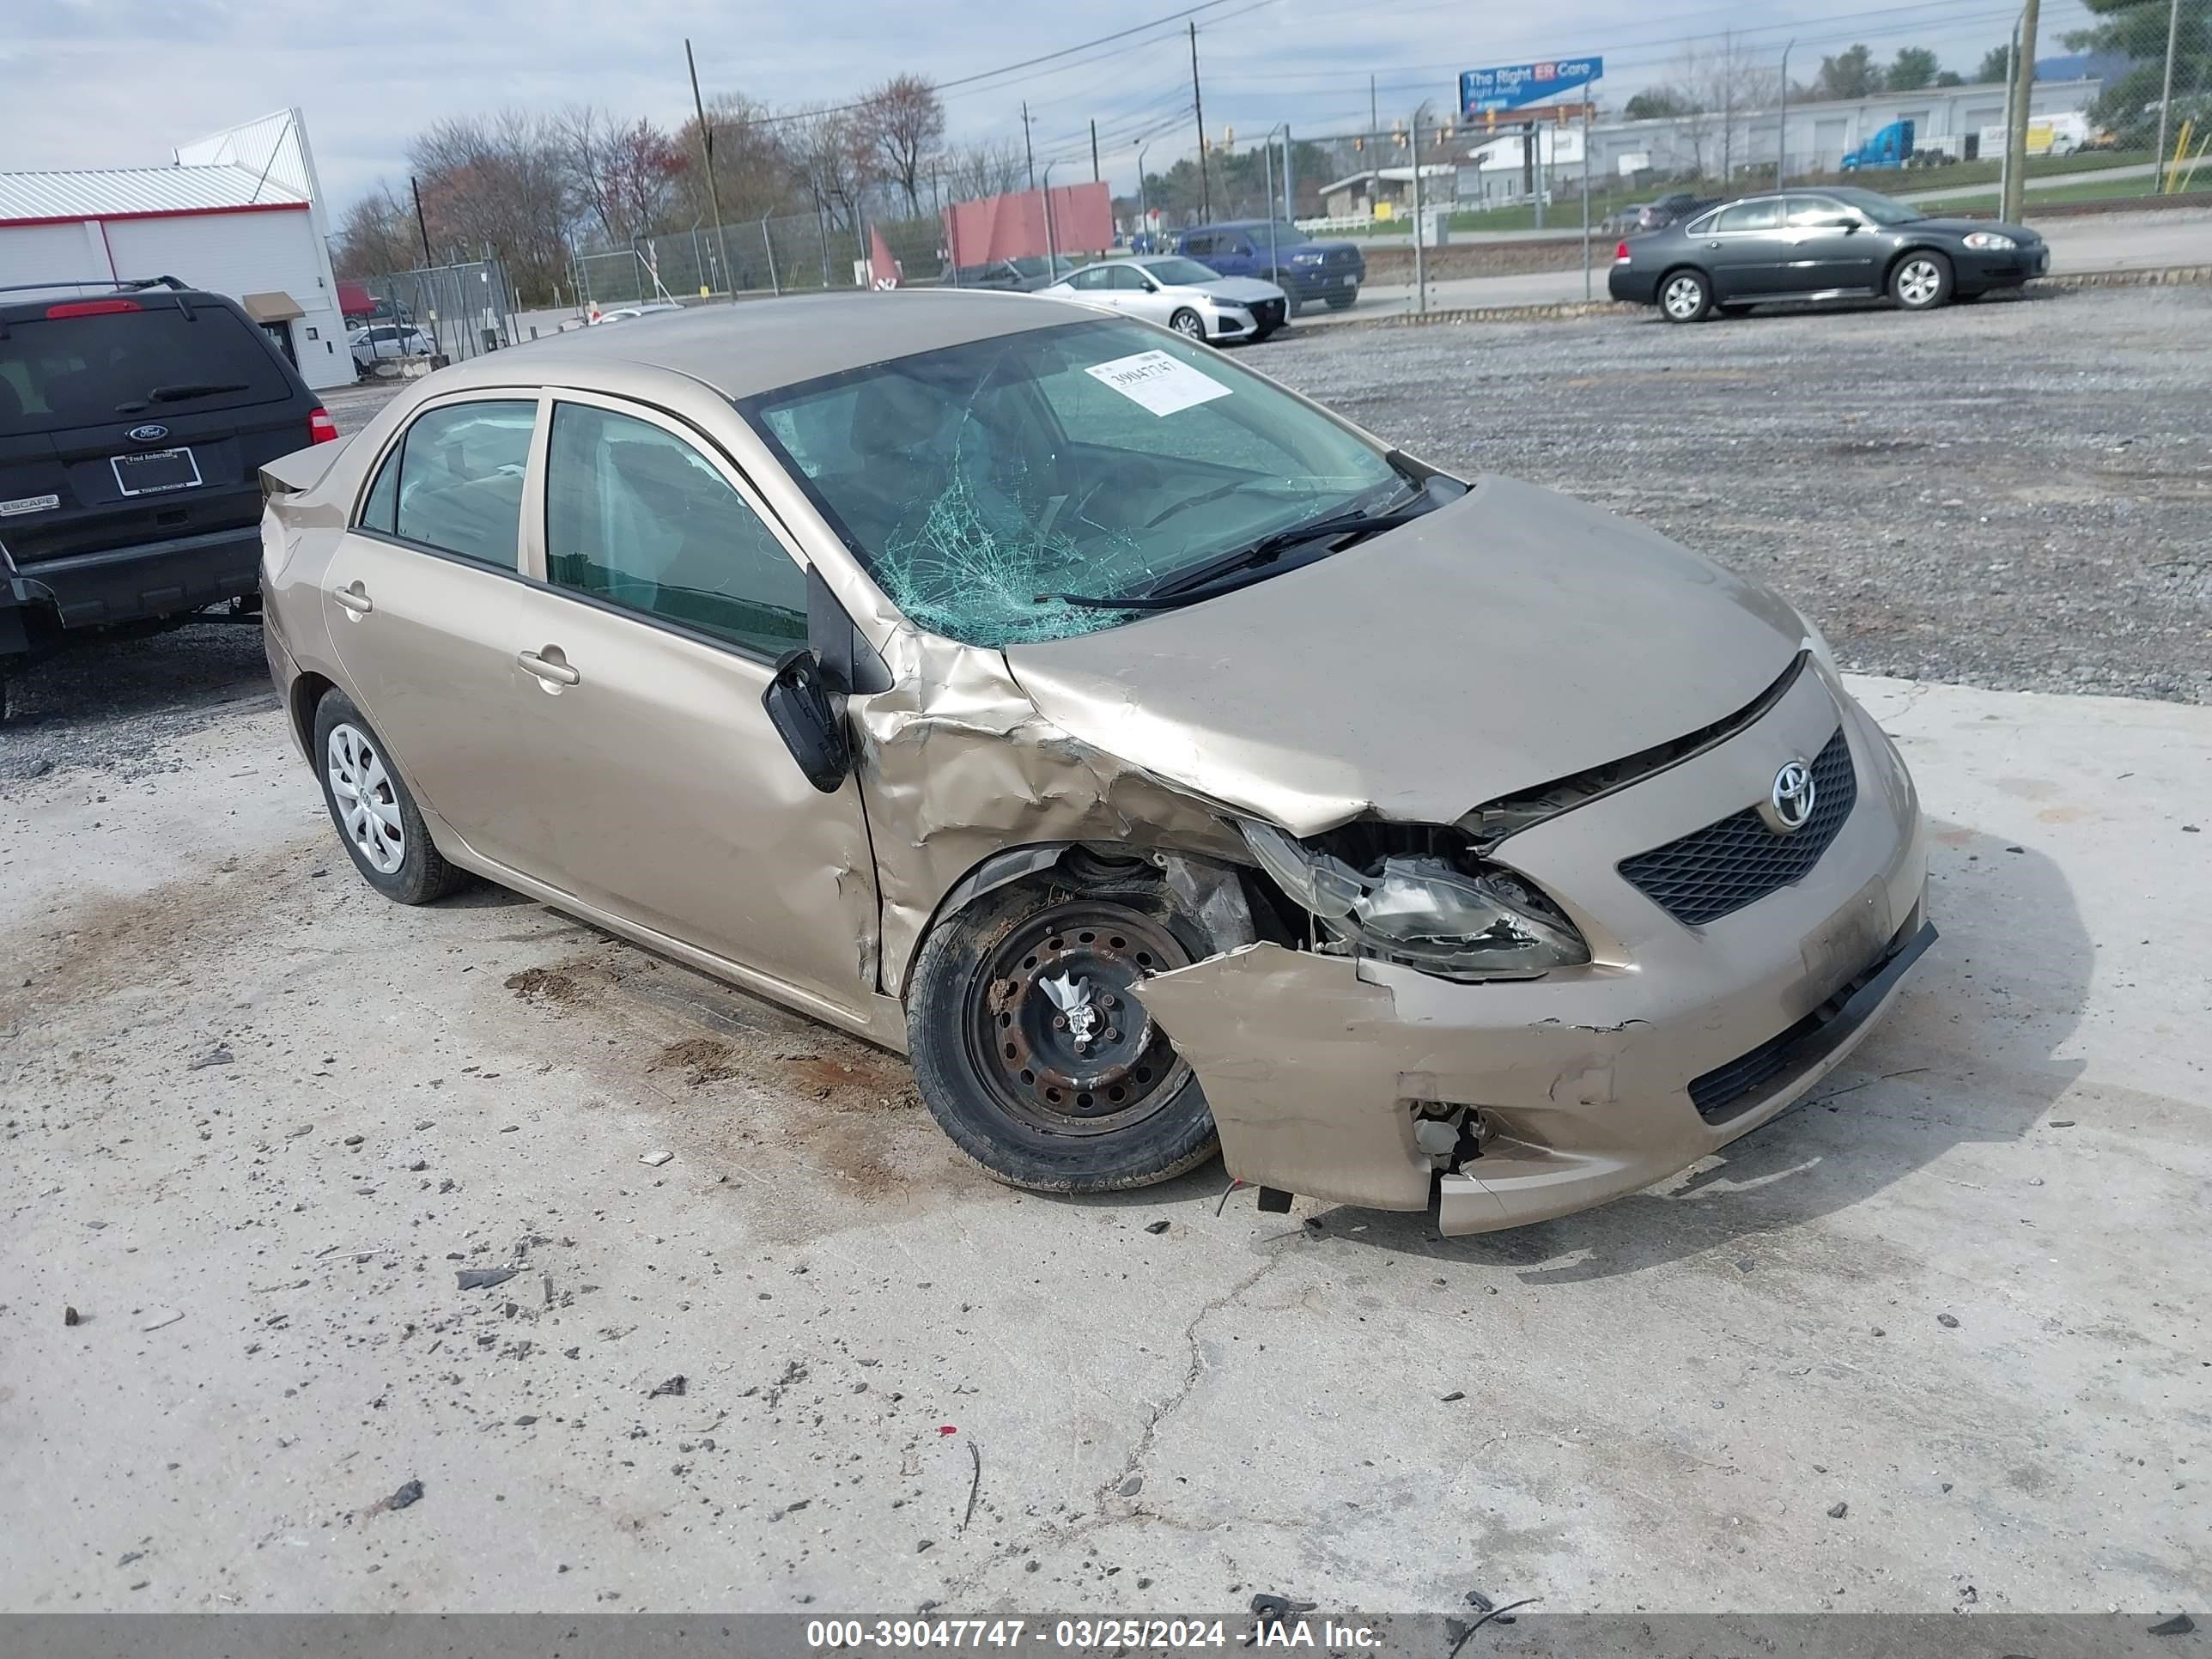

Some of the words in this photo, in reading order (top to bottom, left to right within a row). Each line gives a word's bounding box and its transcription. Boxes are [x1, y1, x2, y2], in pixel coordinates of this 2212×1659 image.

[1468, 72, 1493, 87] The
[1496, 66, 1532, 86] Right
[1534, 64, 1556, 81] ER
[1557, 62, 1590, 77] Care
[1468, 88, 1492, 99] Right
[1111, 361, 1177, 386] 39047747
[139, 428, 161, 438] Ford
[129, 454, 144, 463] Fred
[144, 452, 173, 460] Anderson
[3, 495, 57, 511] ESCAPE
